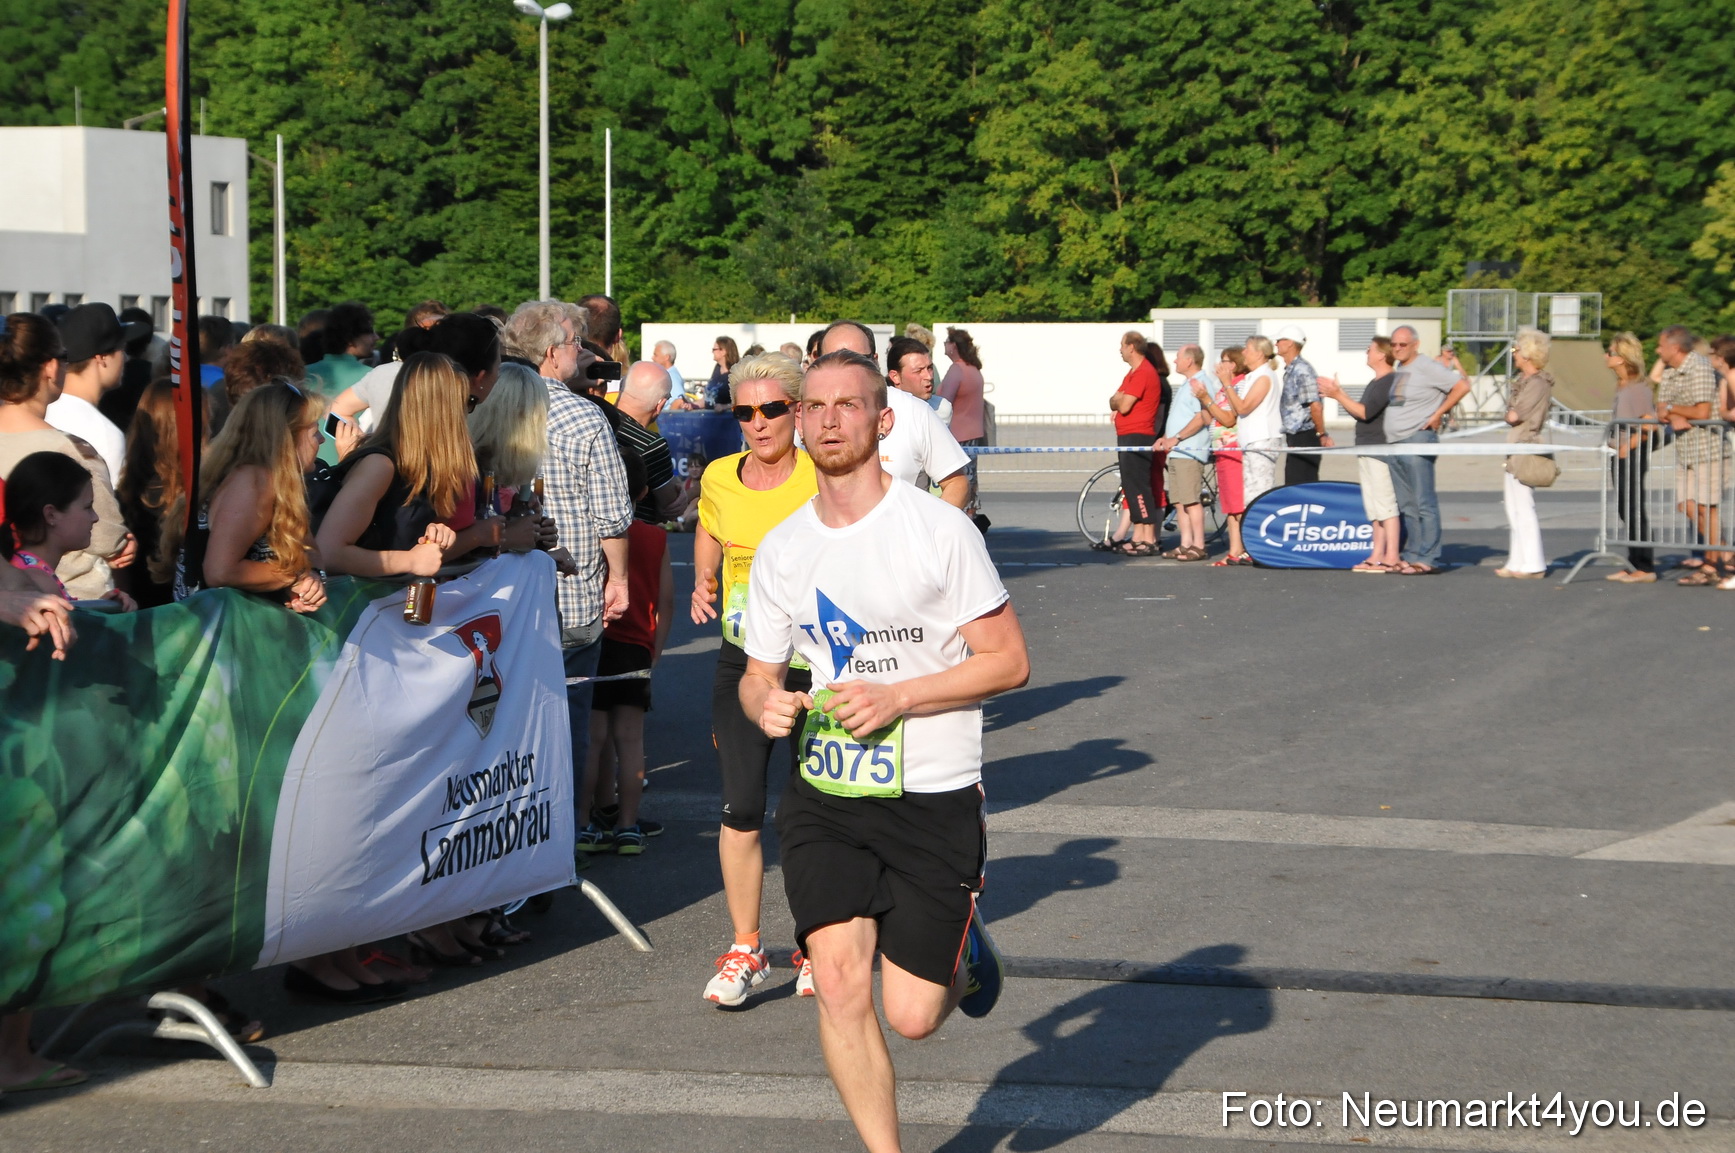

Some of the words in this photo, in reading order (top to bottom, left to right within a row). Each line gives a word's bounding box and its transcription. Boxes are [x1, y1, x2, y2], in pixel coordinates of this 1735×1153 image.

[842, 655, 899, 674] Team
[442, 750, 535, 815] Neumarkter
[805, 737, 895, 784] 5075
[420, 791, 550, 886] Lammsbräu
